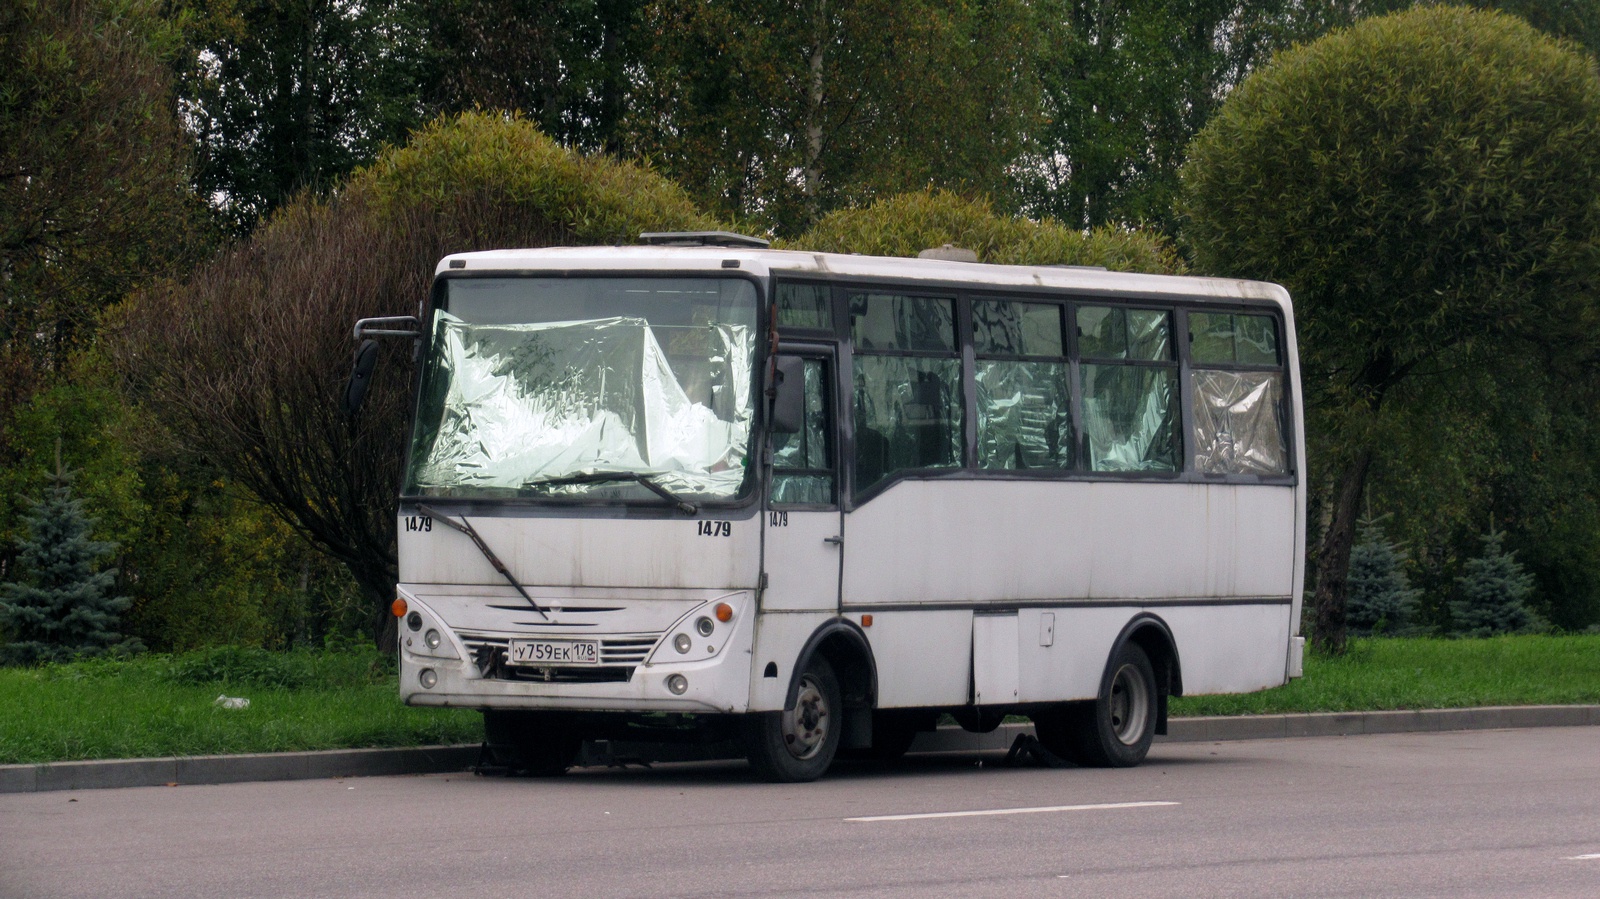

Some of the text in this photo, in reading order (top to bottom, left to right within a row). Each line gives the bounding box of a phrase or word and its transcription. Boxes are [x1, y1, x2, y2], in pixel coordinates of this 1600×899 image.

[405, 516, 432, 532] 1479
[769, 512, 788, 527] 1479
[698, 520, 731, 537] 1479
[573, 644, 593, 655] 178
